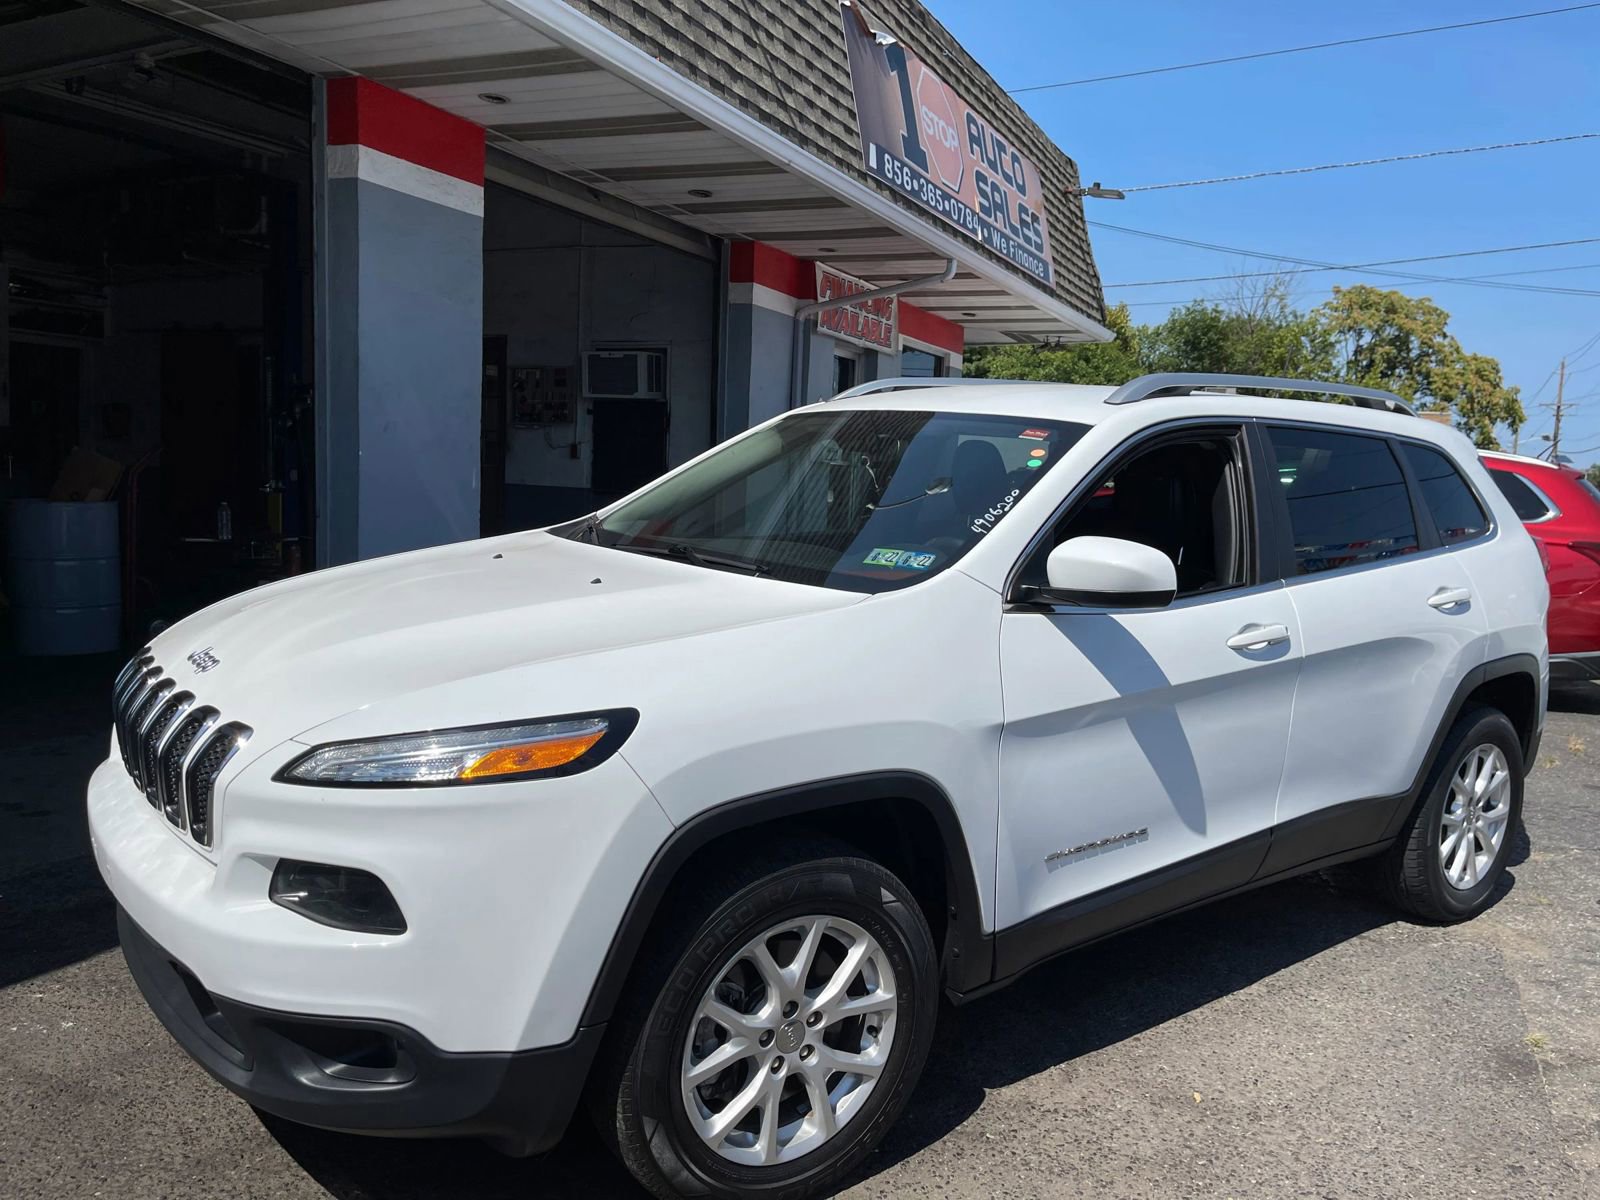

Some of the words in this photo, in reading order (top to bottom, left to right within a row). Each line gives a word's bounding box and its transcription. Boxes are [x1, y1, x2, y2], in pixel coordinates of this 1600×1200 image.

[885, 44, 930, 175] 1
[921, 105, 959, 151] STOP
[965, 110, 1027, 199] AUTO
[973, 169, 1045, 255] SALES
[991, 227, 1007, 254] We
[1009, 240, 1044, 277] Finance
[971, 488, 1020, 534] 4906200
[187, 646, 221, 675] Jeep
